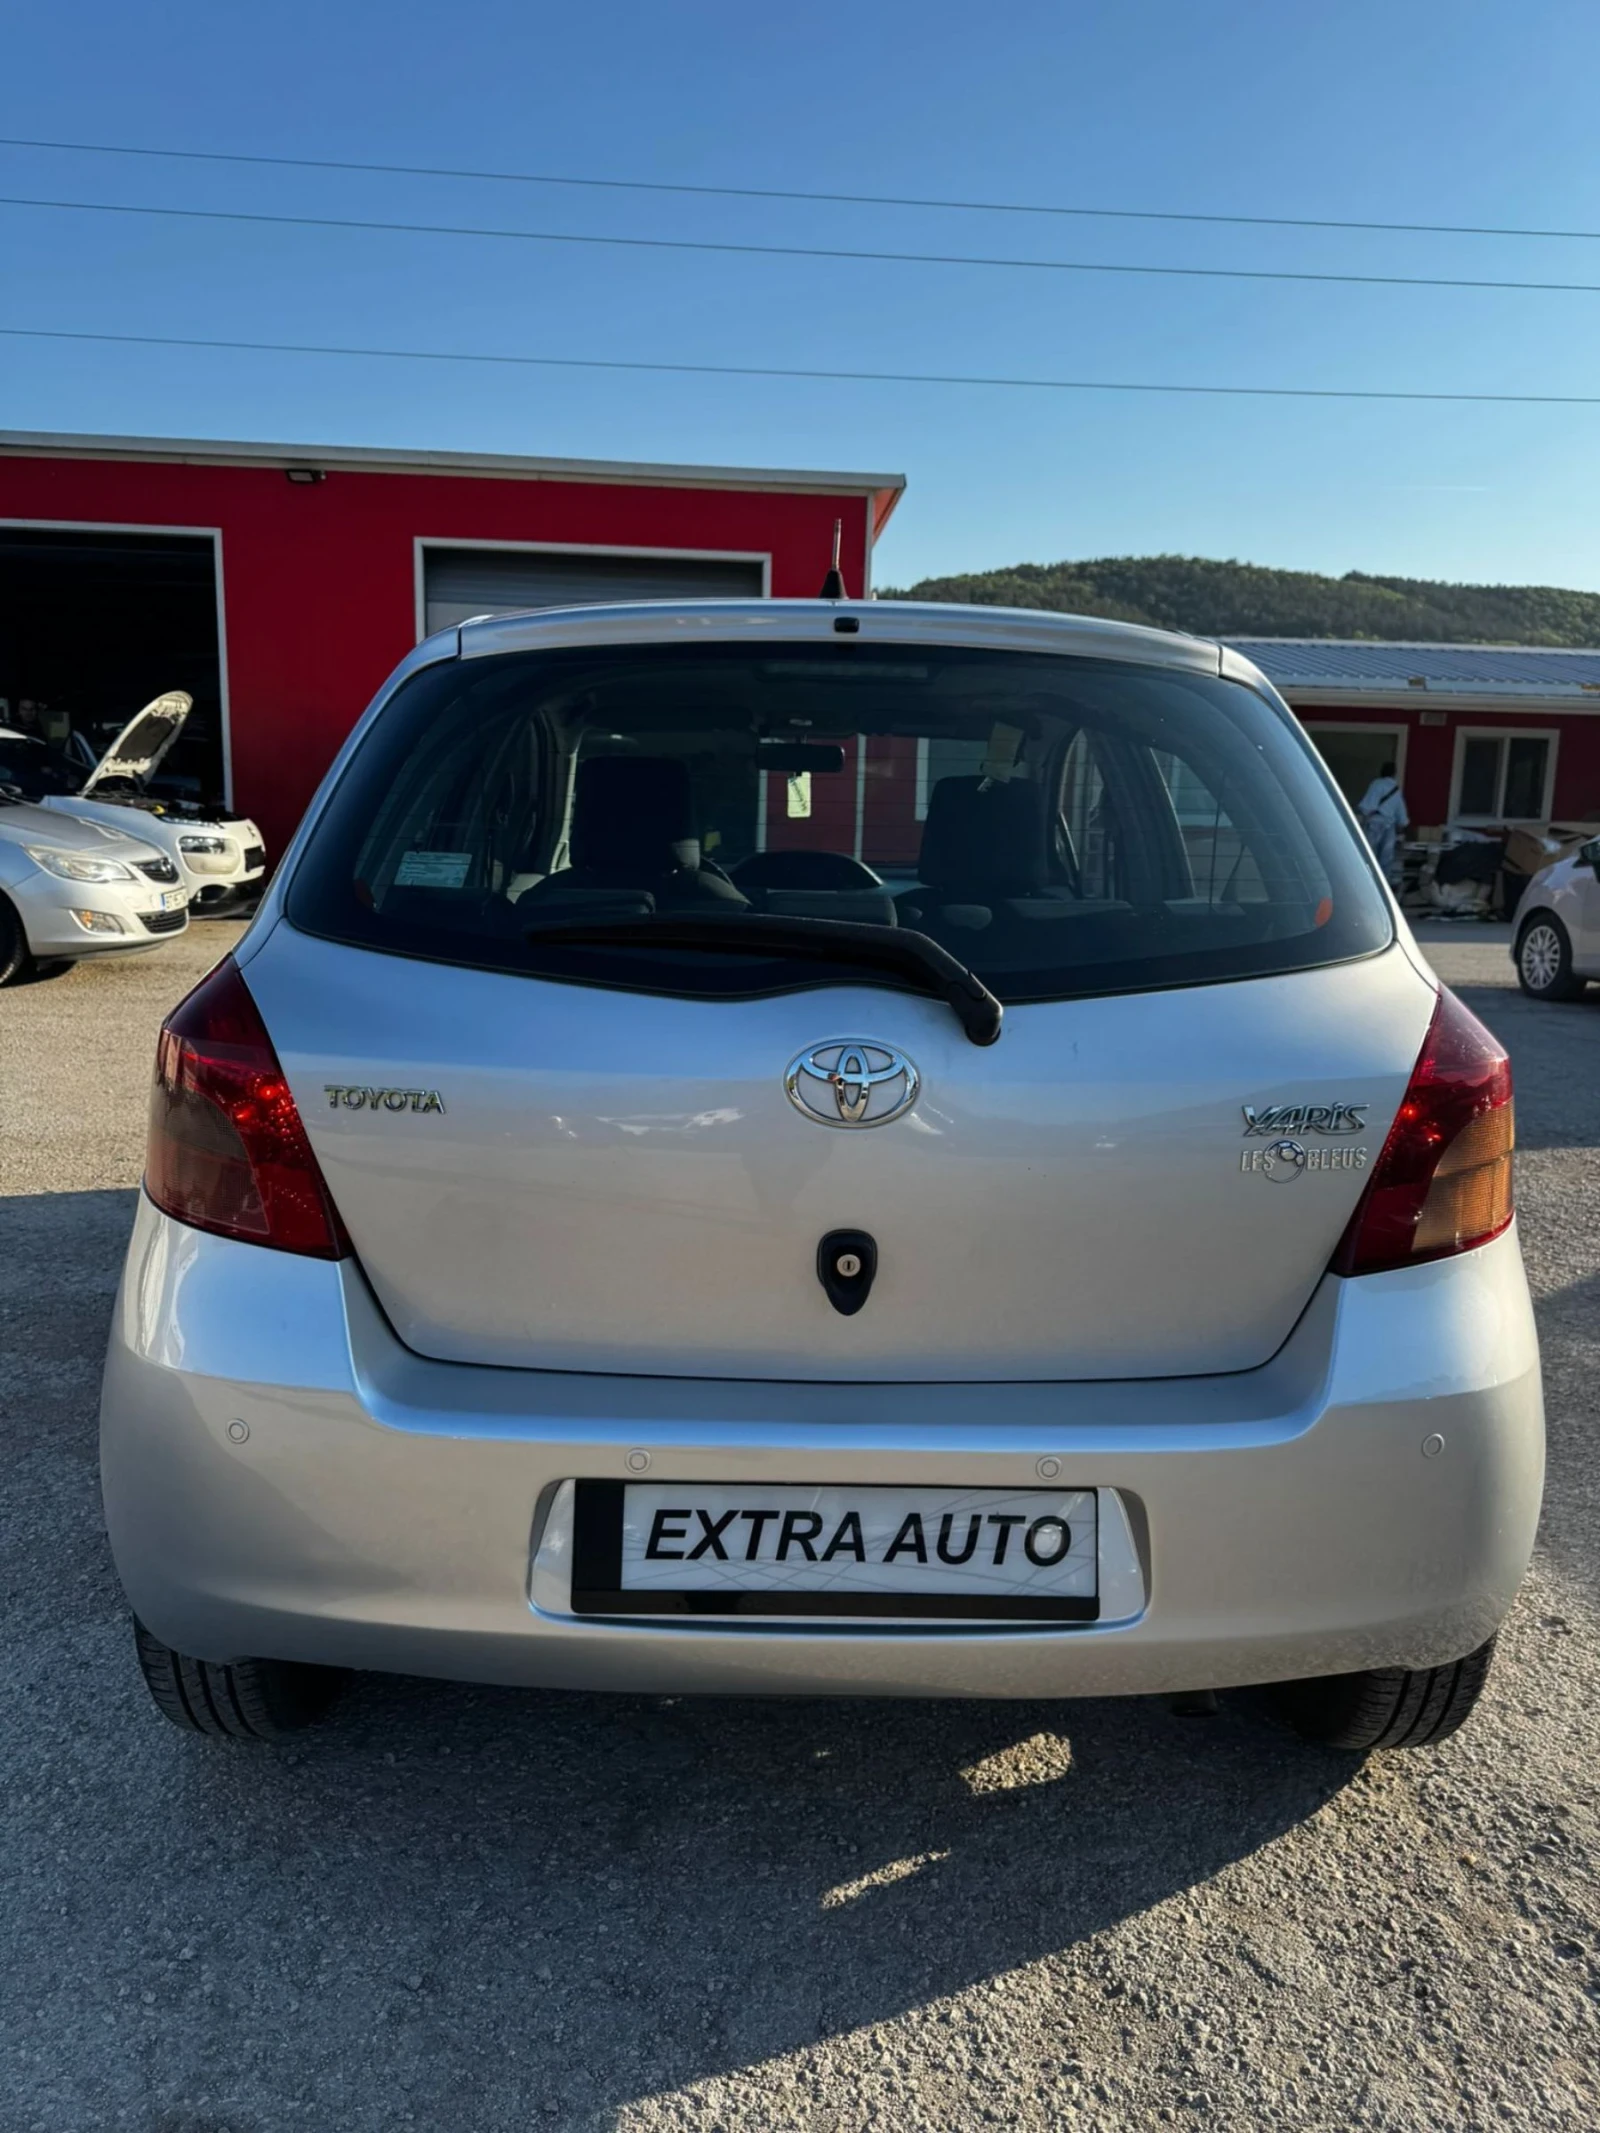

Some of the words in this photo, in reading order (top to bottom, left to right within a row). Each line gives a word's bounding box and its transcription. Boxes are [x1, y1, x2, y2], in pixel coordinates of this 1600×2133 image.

[324, 1084, 446, 1114] TOYOTA
[1240, 1150, 1276, 1172] LES
[1306, 1147, 1368, 1171] BLEUS
[645, 1509, 866, 1563] EXTRA
[883, 1512, 1072, 1567] AUTO
